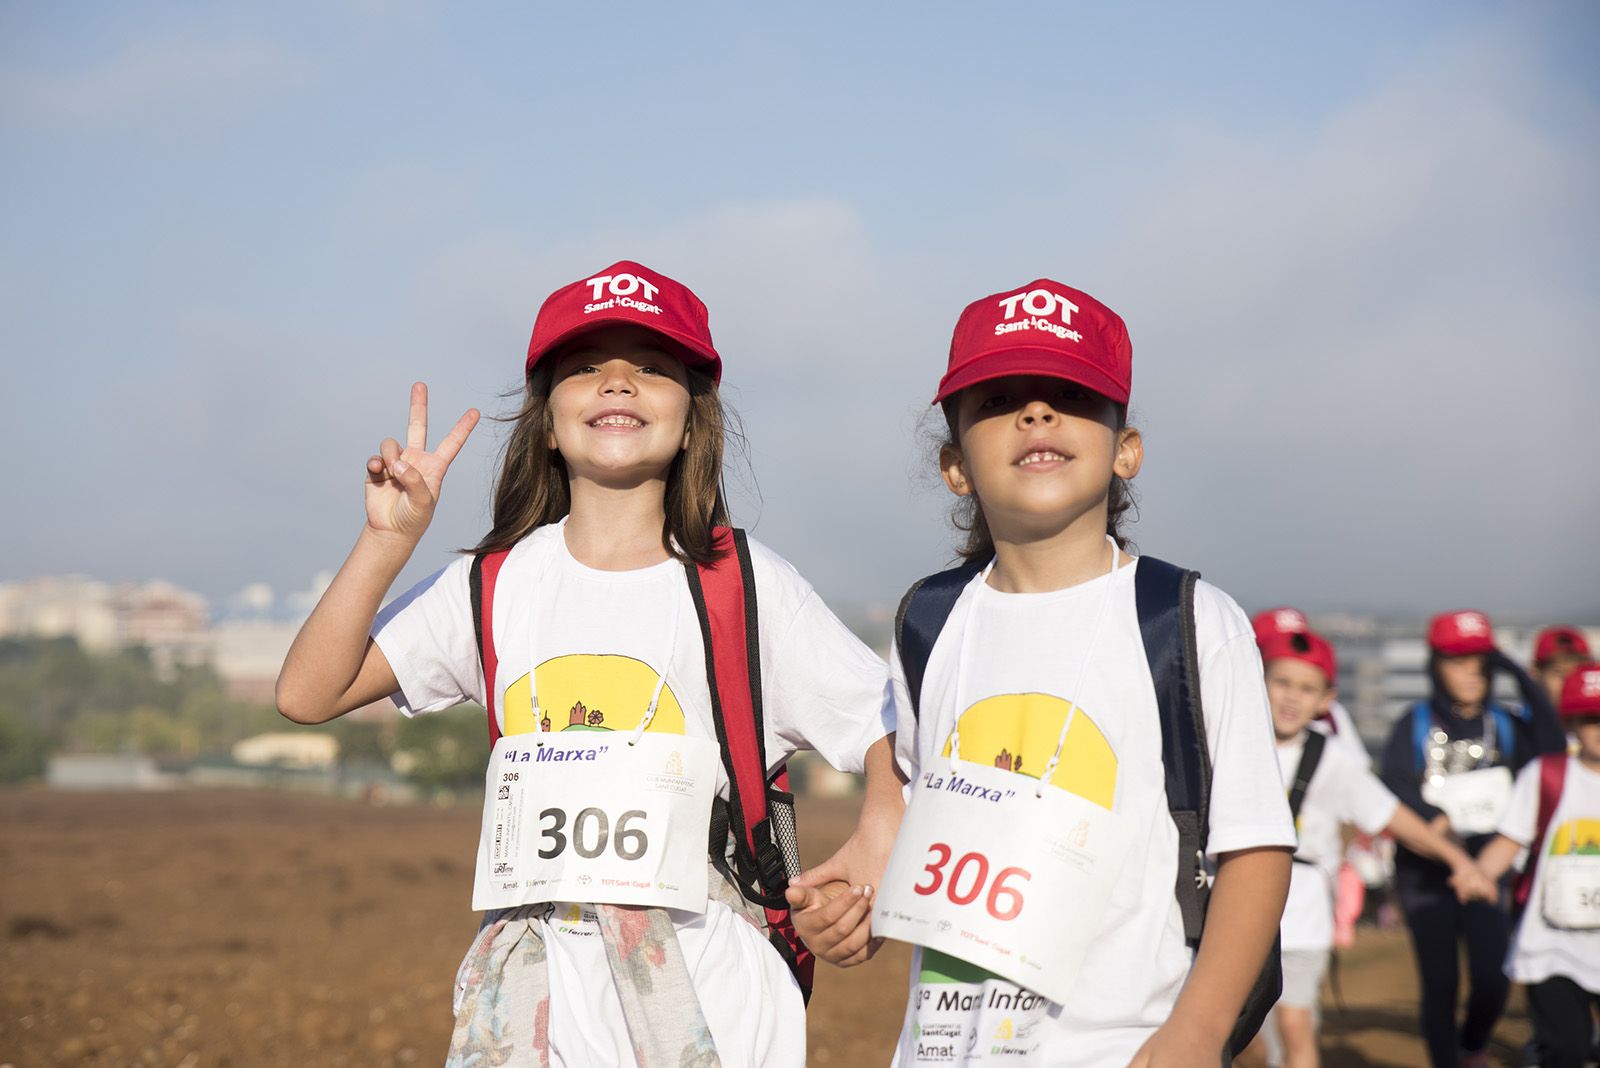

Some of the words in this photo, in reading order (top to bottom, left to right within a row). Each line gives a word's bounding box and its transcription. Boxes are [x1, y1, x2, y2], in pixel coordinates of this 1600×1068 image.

[586, 273, 659, 301] TOT
[583, 298, 614, 314] Sant
[620, 297, 663, 315] Cugat
[998, 289, 1079, 325] TOT
[994, 318, 1030, 336] Sant
[1037, 318, 1083, 343] Cugat
[502, 772, 520, 783] 306
[537, 806, 649, 861] 306
[913, 842, 1032, 922] 306
[936, 989, 984, 1012] Mar
